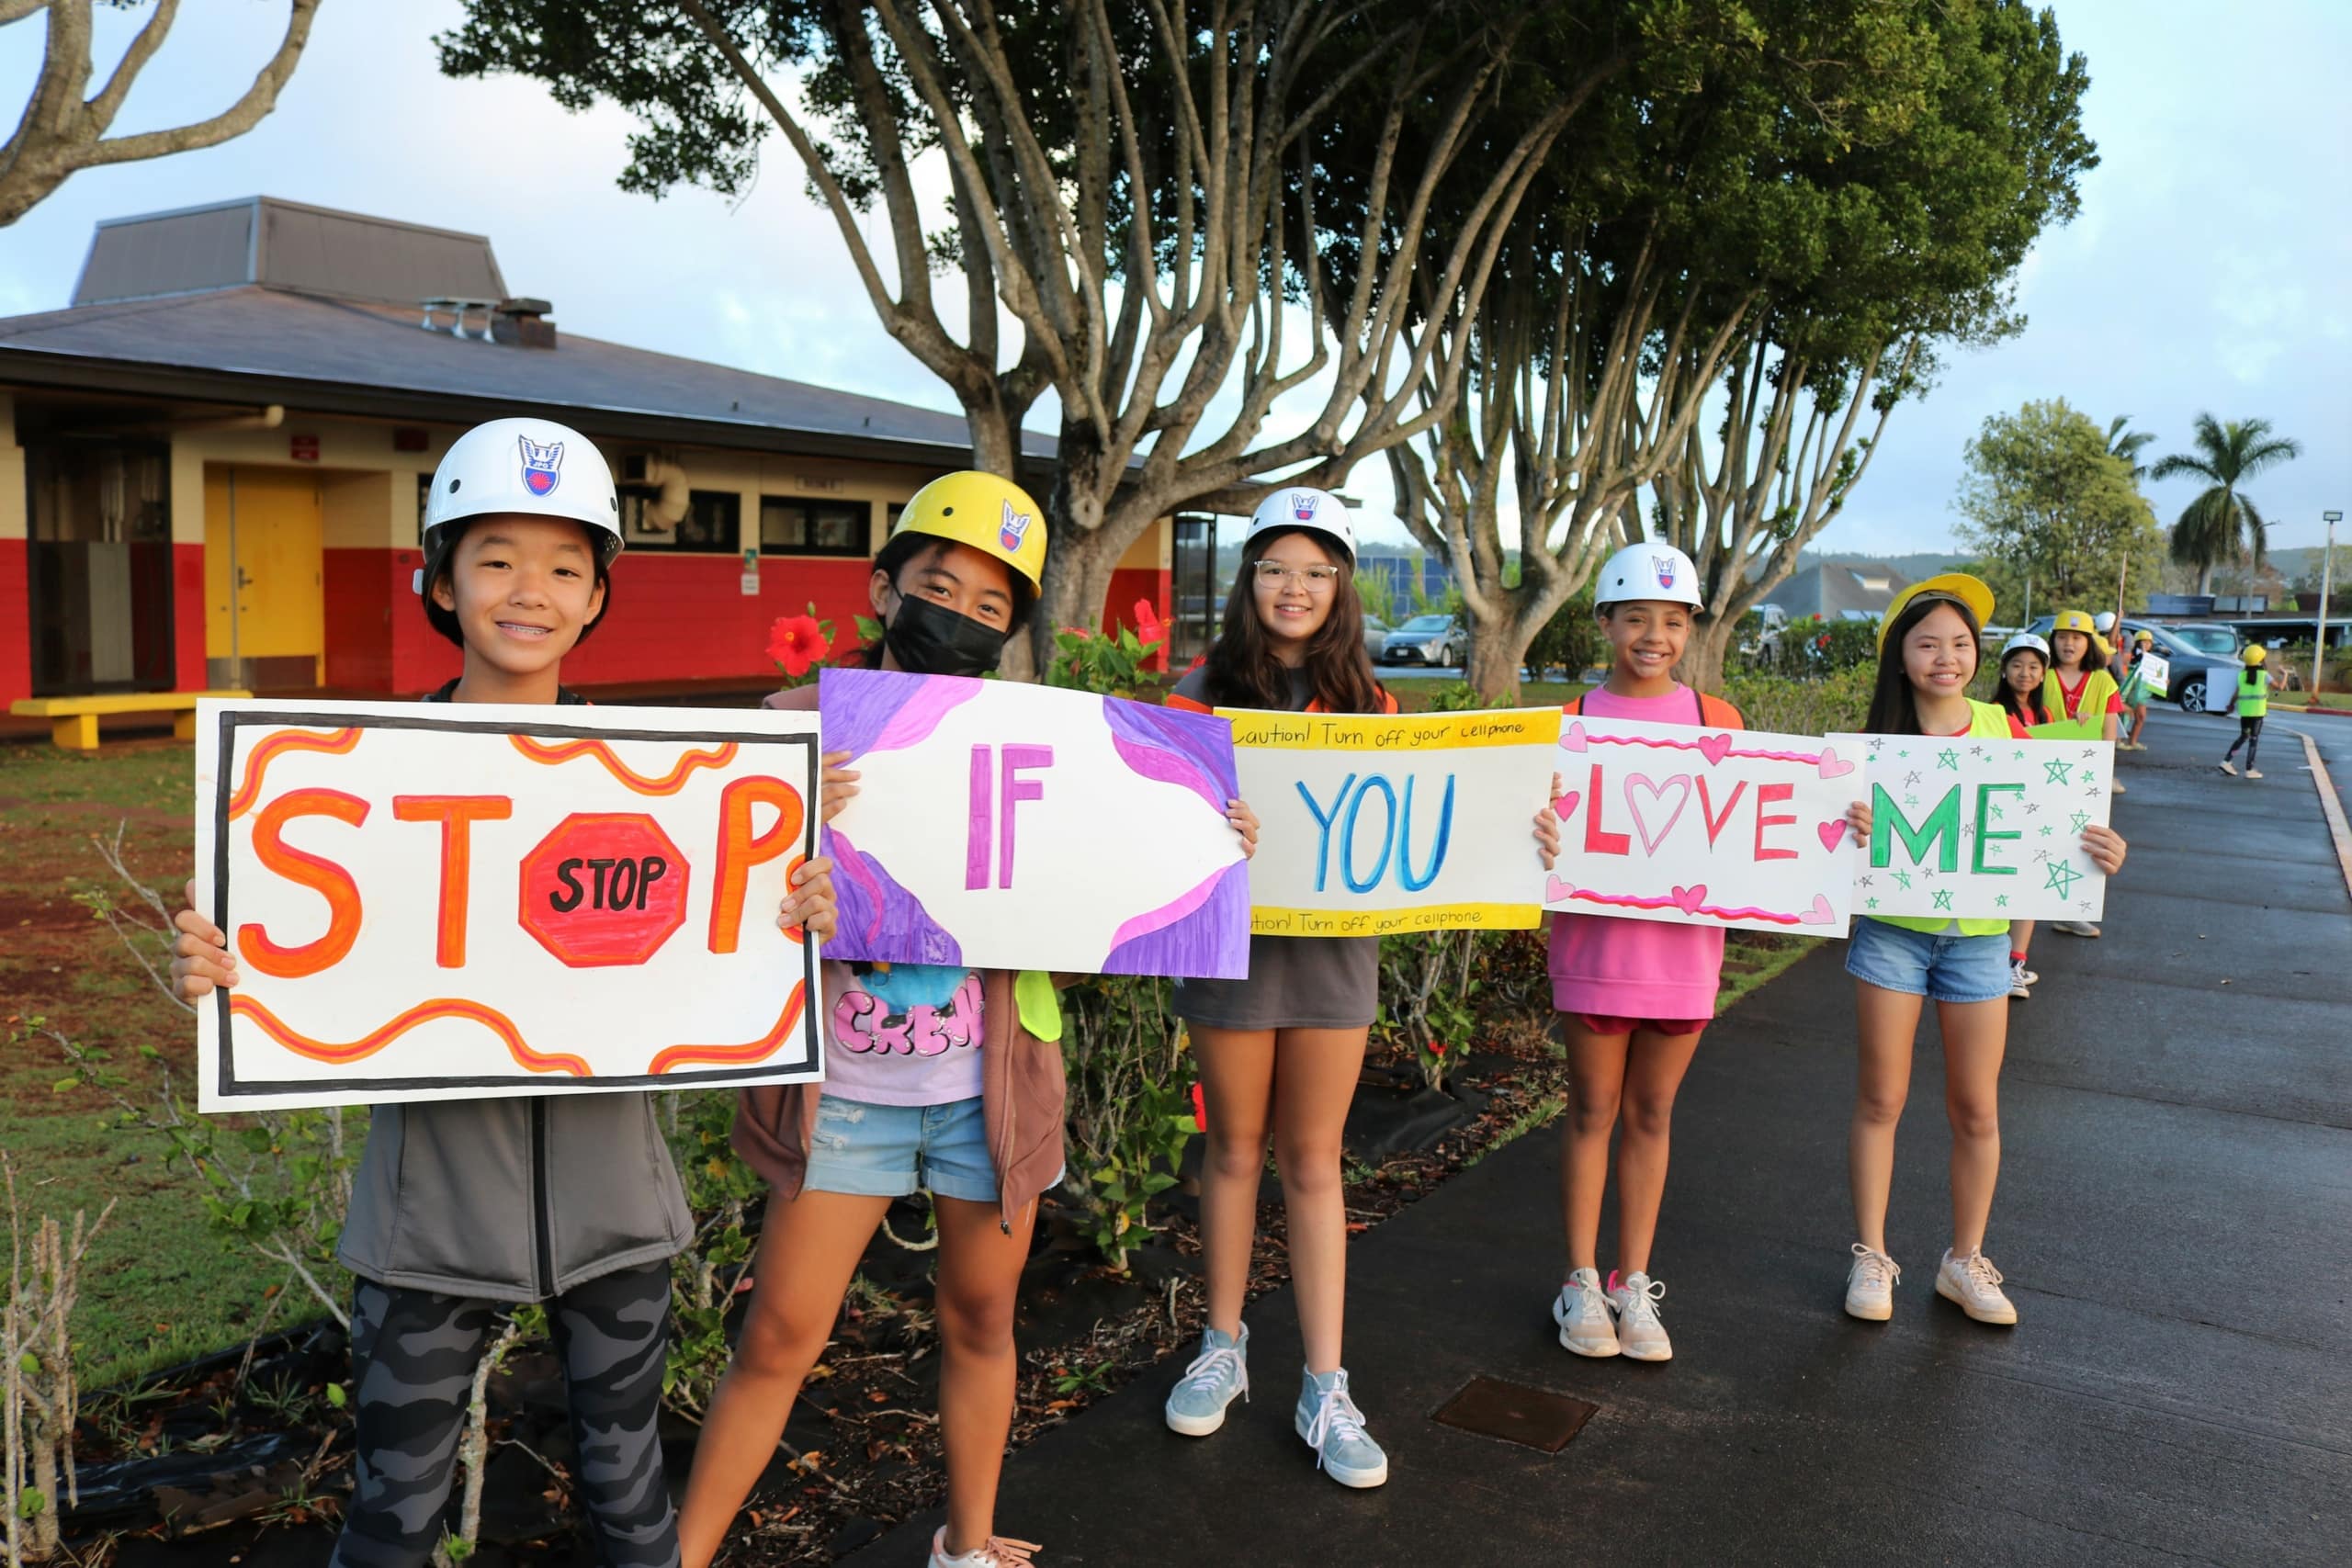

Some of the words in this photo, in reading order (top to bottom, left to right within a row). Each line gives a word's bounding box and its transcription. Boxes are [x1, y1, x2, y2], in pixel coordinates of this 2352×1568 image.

[1320, 722, 1363, 745] Turn
[1374, 728, 1405, 747] off
[1409, 725, 1452, 747] your
[1460, 723, 1526, 738] cellphone
[965, 743, 1055, 890] IF
[1294, 772, 1455, 894] YOU
[1870, 781, 2027, 875] ME
[548, 855, 667, 913] STOP
[1297, 912, 1334, 932] Turn
[1340, 914, 1371, 931] off
[1373, 916, 1408, 935] your
[1415, 910, 1483, 927] cellphone
